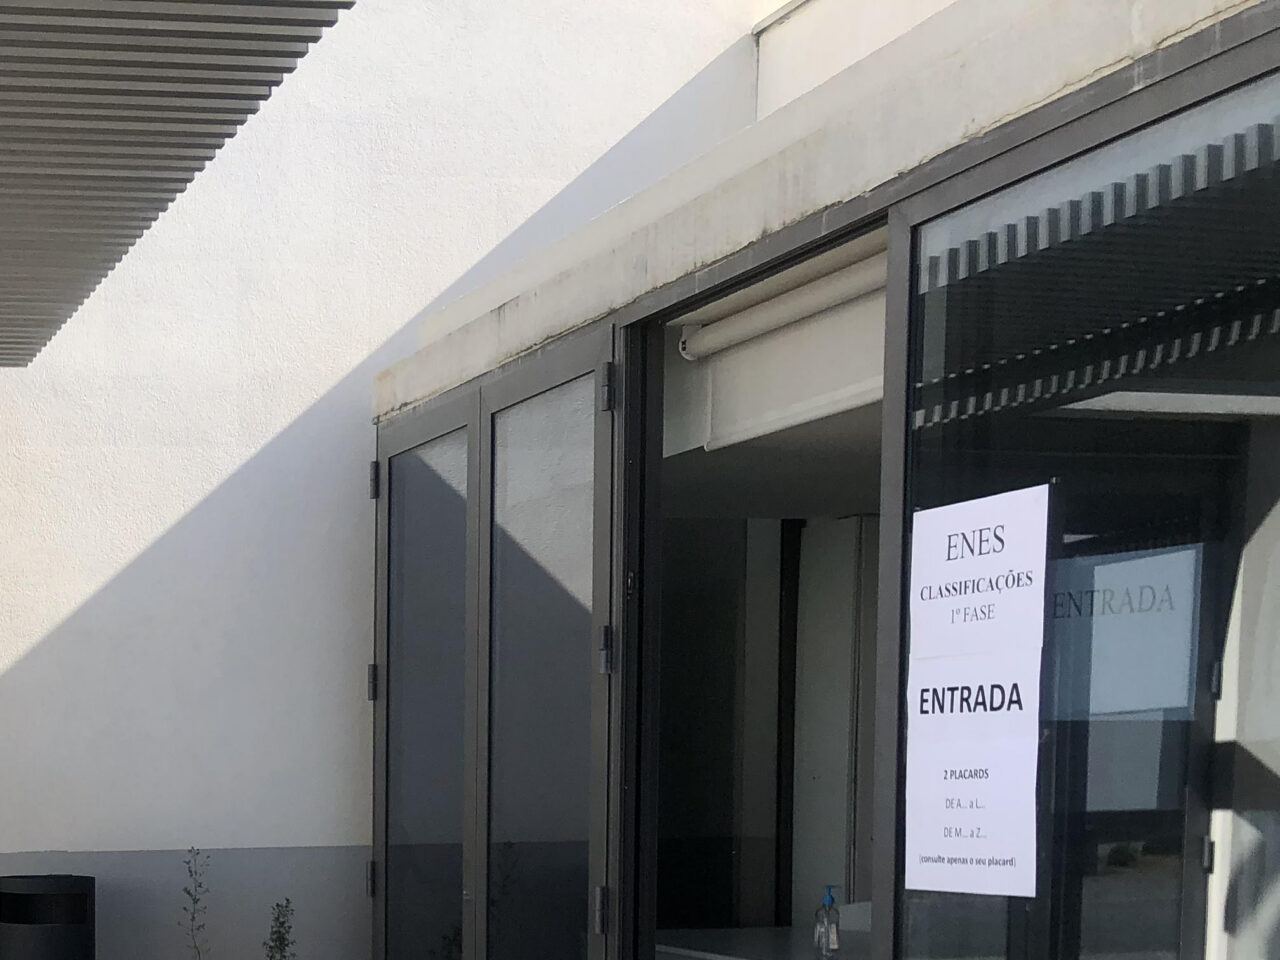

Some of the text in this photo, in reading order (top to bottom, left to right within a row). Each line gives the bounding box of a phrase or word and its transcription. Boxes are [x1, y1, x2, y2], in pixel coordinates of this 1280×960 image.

[945, 524, 1005, 561] ENES
[920, 569, 1033, 602] CLASSIFICAÇÕES
[1053, 584, 1176, 619] ENTRADA
[963, 603, 996, 623] FASE
[920, 682, 1023, 714] ENTRADA
[943, 768, 989, 780] 2 PLACARDS
[945, 798, 955, 809] DE
[943, 827, 953, 838] DE
[919, 853, 1017, 868] (consulte apenas o seu placard)
